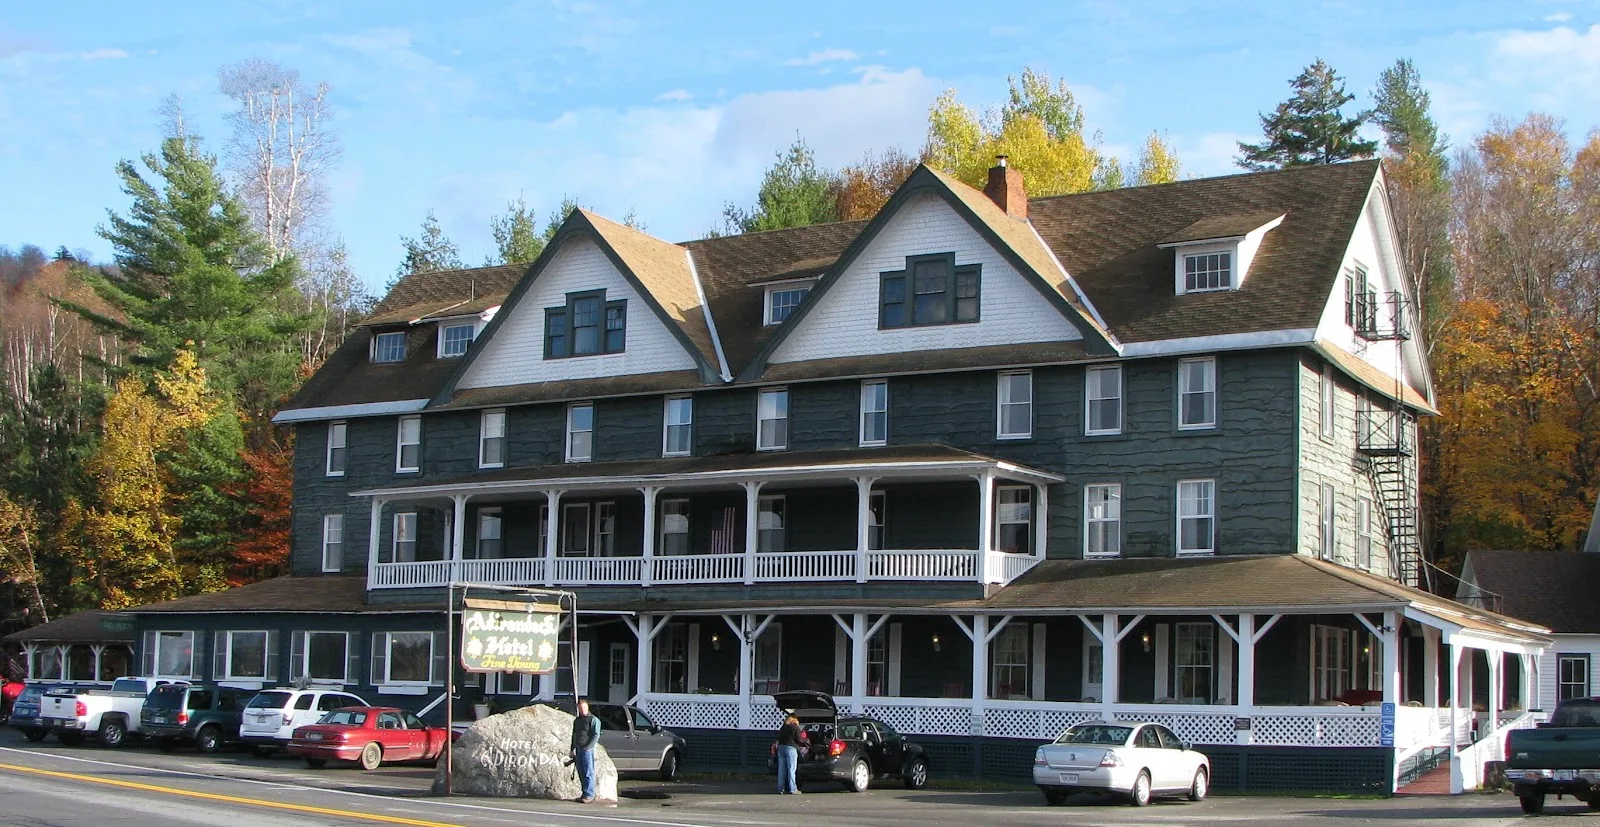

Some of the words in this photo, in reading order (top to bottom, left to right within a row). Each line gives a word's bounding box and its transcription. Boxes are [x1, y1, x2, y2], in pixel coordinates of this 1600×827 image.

[466, 612, 556, 636] Adirondack
[485, 636, 533, 656] Hotel
[481, 655, 506, 668] Fine
[507, 656, 540, 671] Dining
[481, 747, 573, 768] ADIRONDAC
